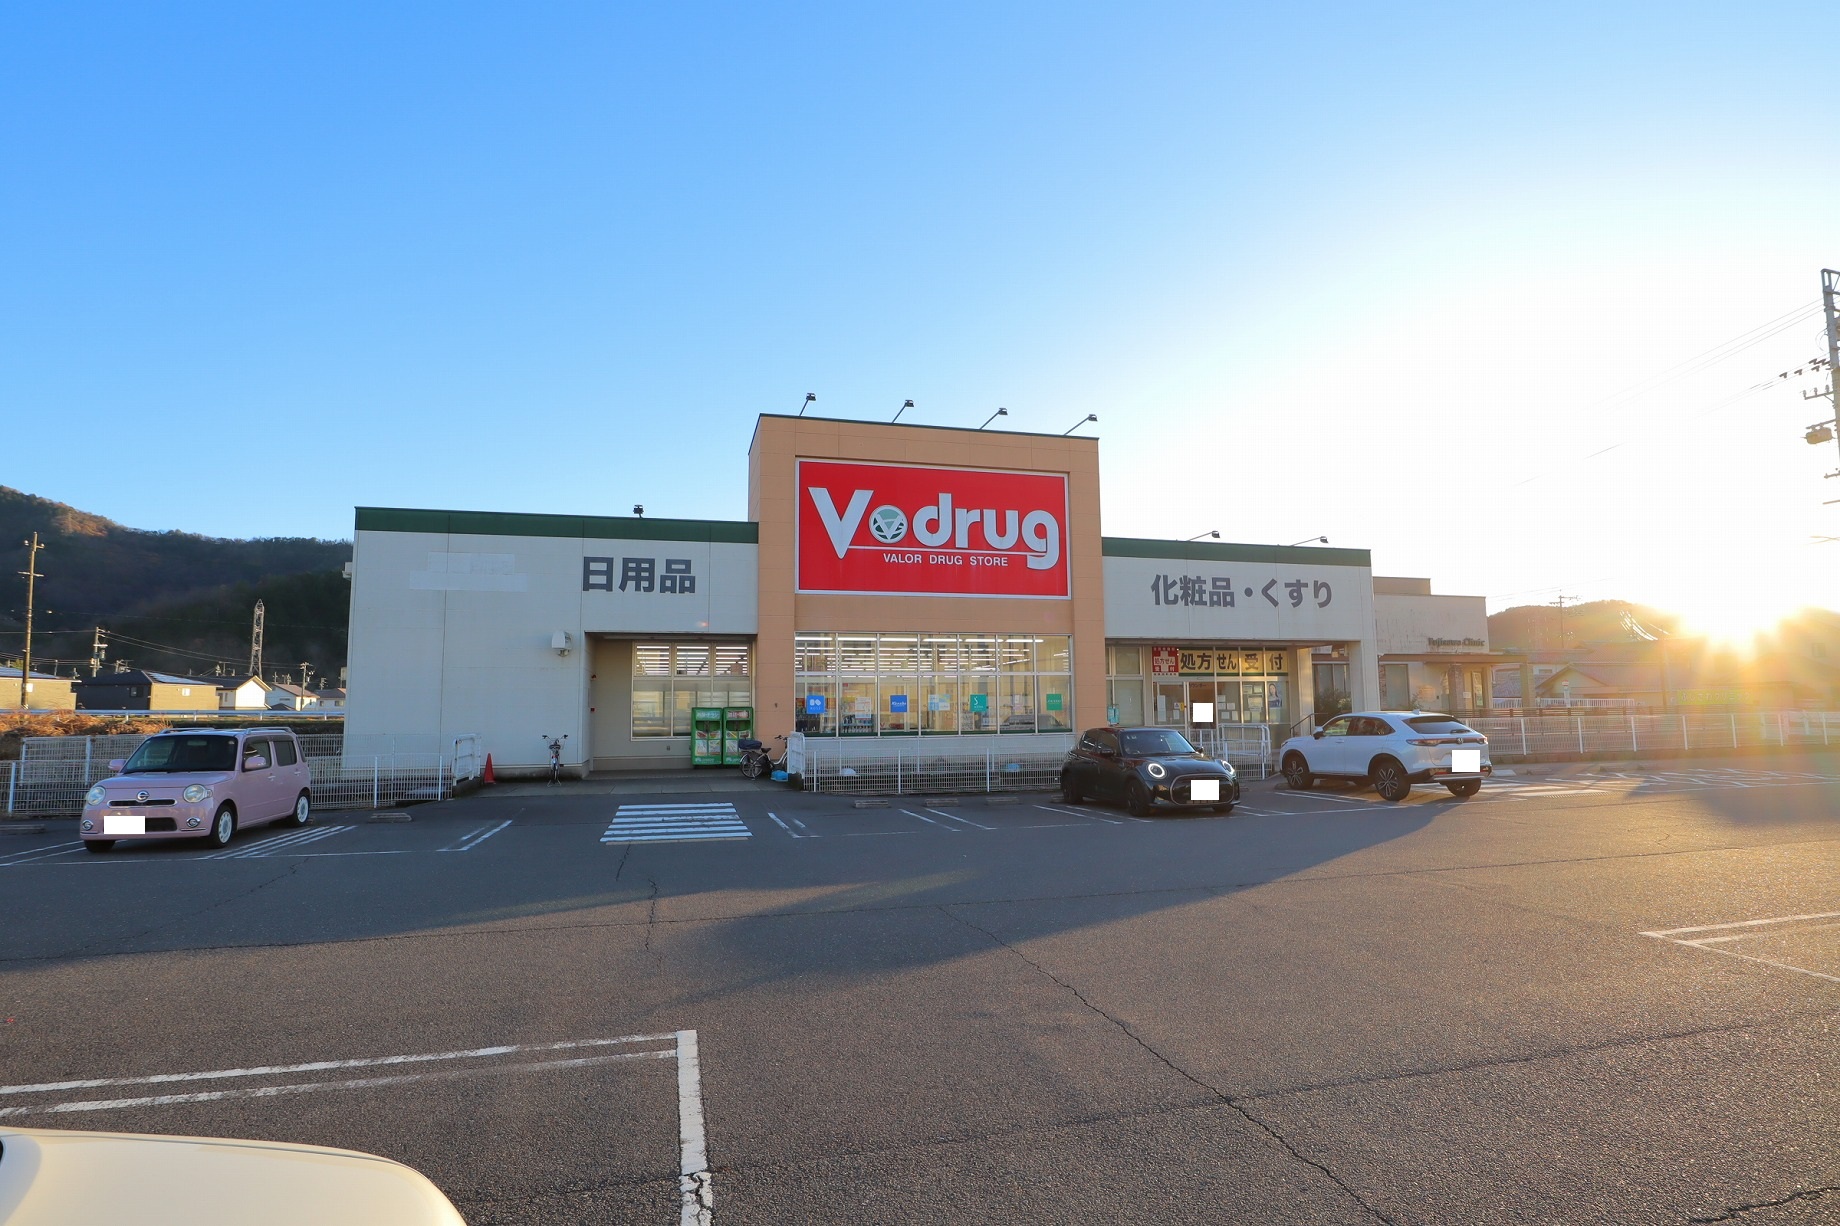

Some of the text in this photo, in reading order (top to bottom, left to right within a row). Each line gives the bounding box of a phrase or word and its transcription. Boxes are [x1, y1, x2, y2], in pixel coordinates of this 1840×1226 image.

[883, 553, 1008, 566] VALOR DRUG STORE
[583, 556, 696, 594] 日用品
[1151, 574, 1332, 608] 化粧品・くすり
[1462, 637, 1485, 646] Clinic
[1154, 657, 1175, 665] 処方せん
